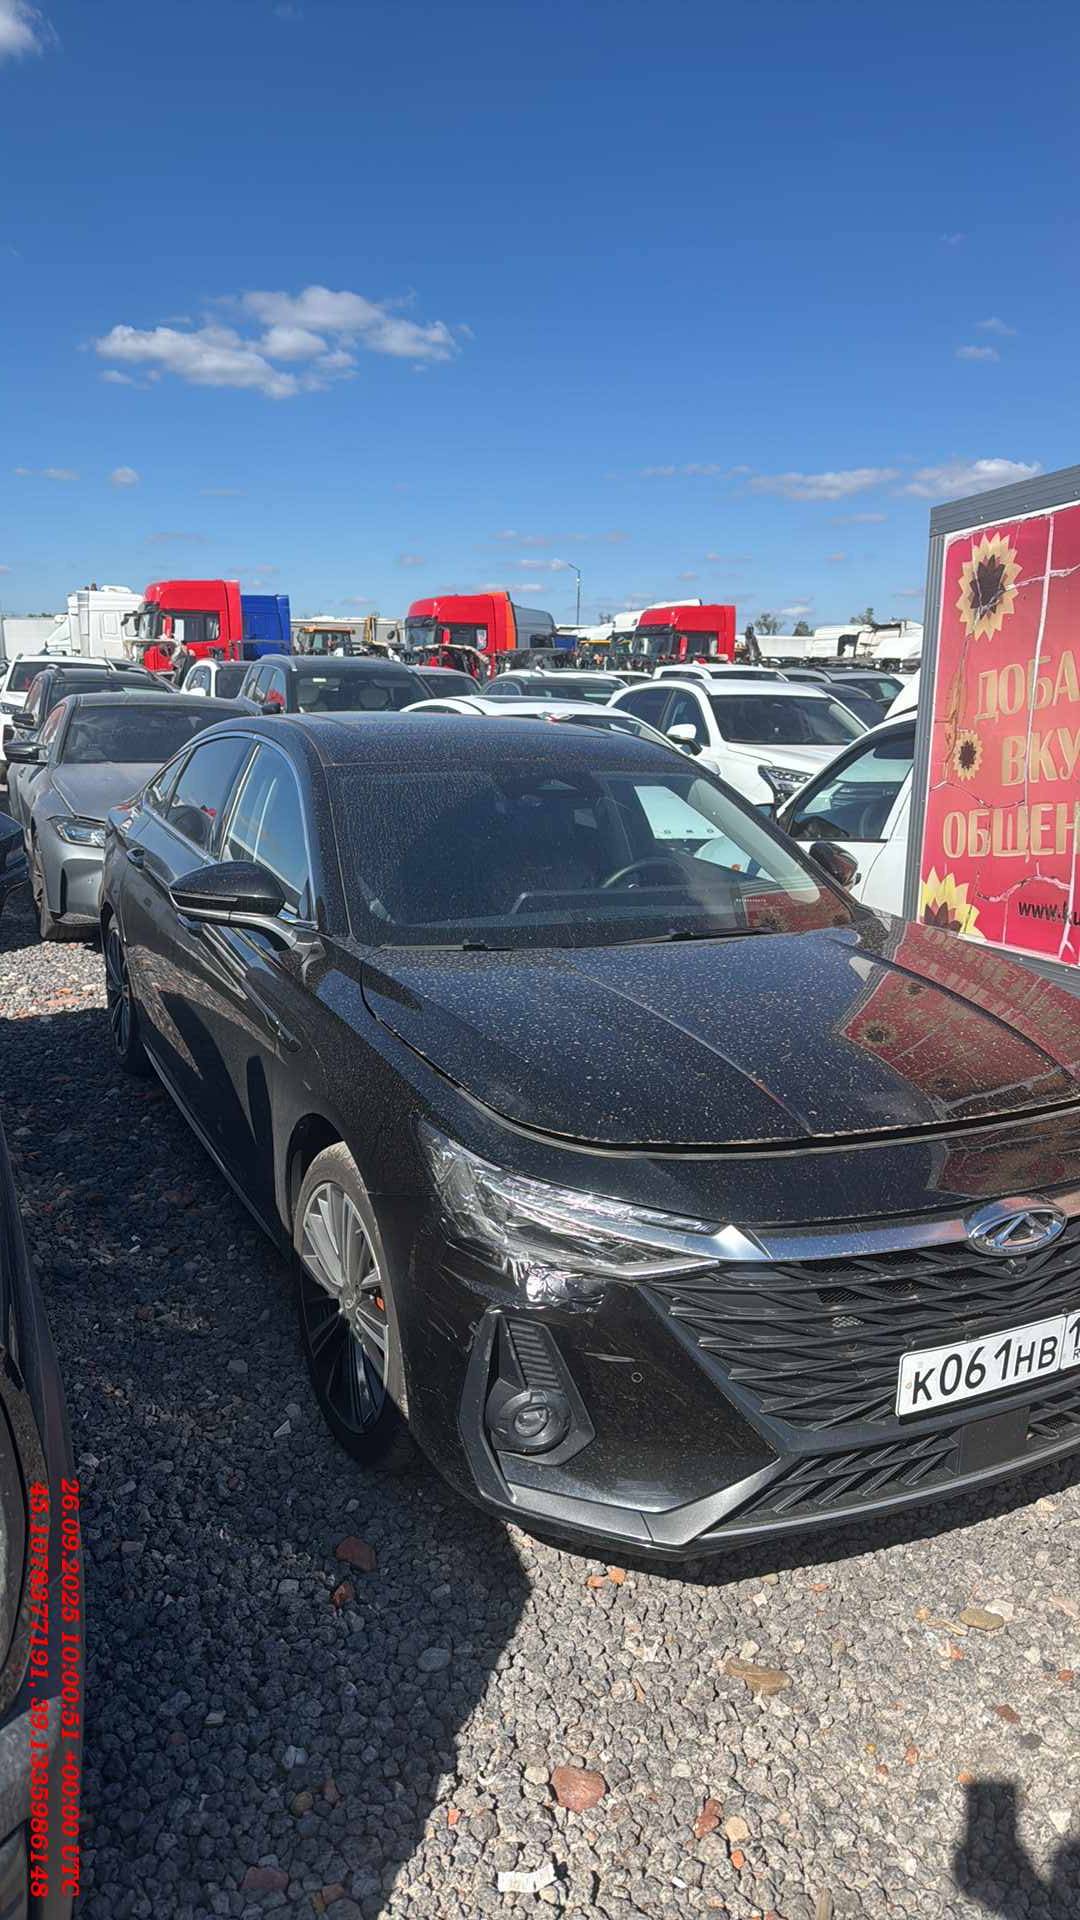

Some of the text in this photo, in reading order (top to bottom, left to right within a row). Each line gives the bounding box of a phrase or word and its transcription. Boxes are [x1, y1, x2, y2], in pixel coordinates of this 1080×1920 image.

[974, 650, 1080, 726] ДОБА
[1001, 724, 1080, 786] ВКУ
[943, 800, 1080, 864] ОБЩЕН
[912, 1336, 1058, 1405] К061НВ
